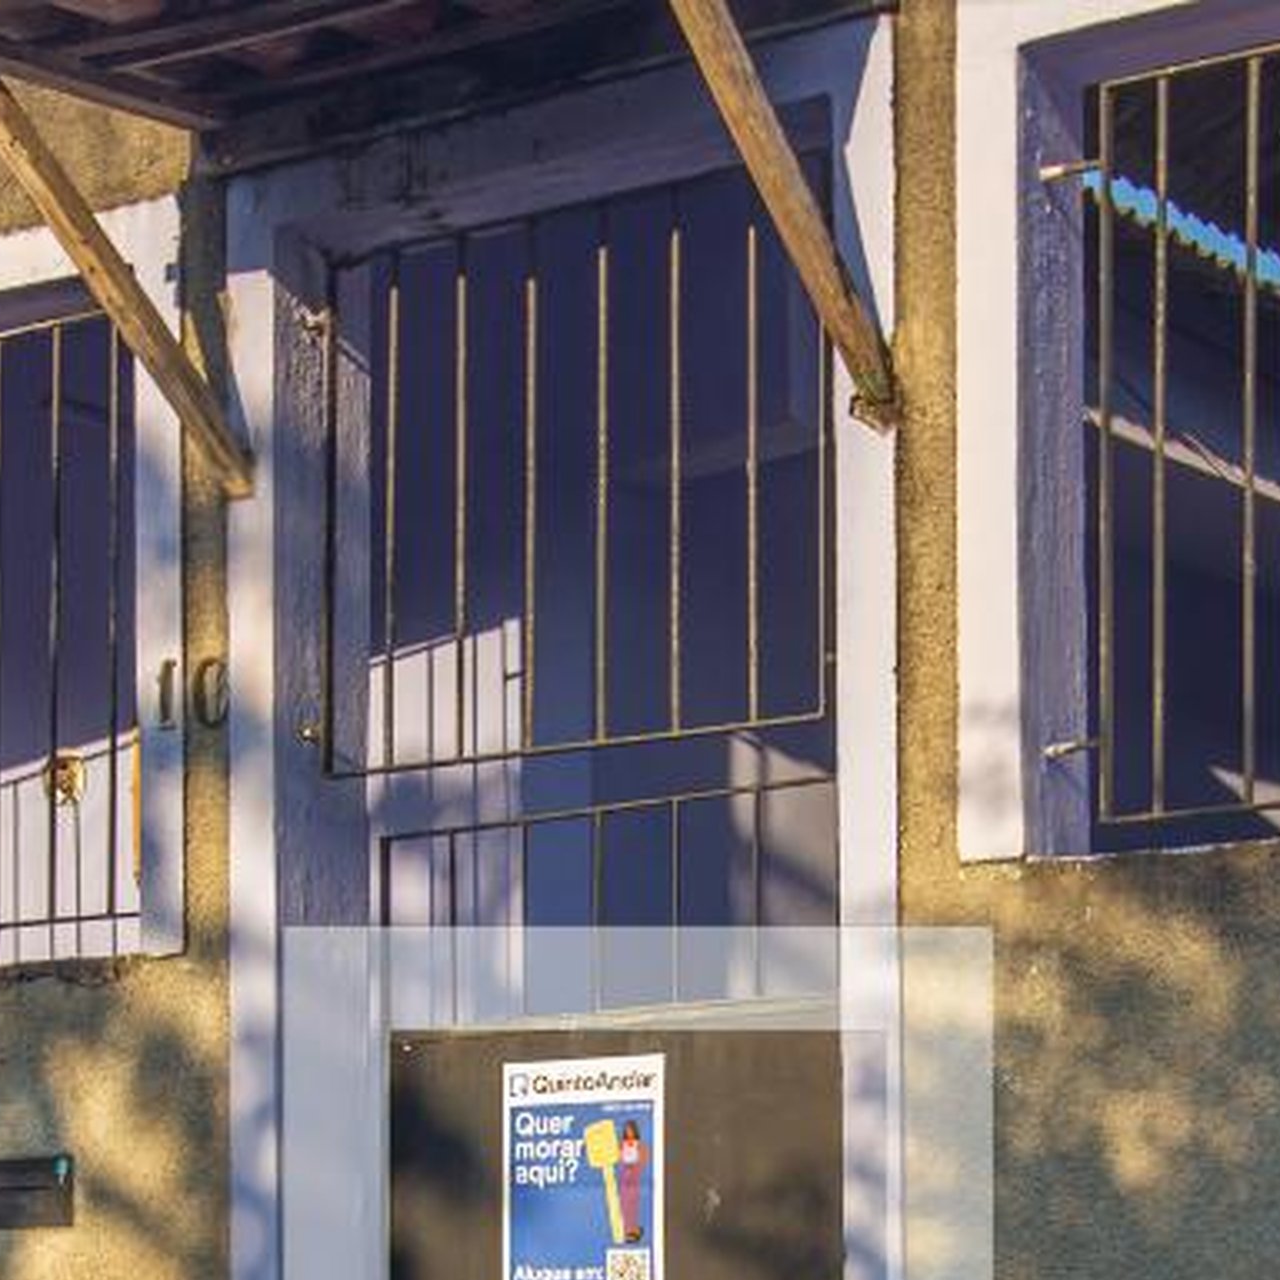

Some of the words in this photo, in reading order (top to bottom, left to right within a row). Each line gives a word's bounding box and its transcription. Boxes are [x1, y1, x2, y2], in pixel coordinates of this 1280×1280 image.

[515, 1112, 574, 1137] Quer
[515, 1139, 585, 1160] morar
[515, 1159, 579, 1190] aqui?
